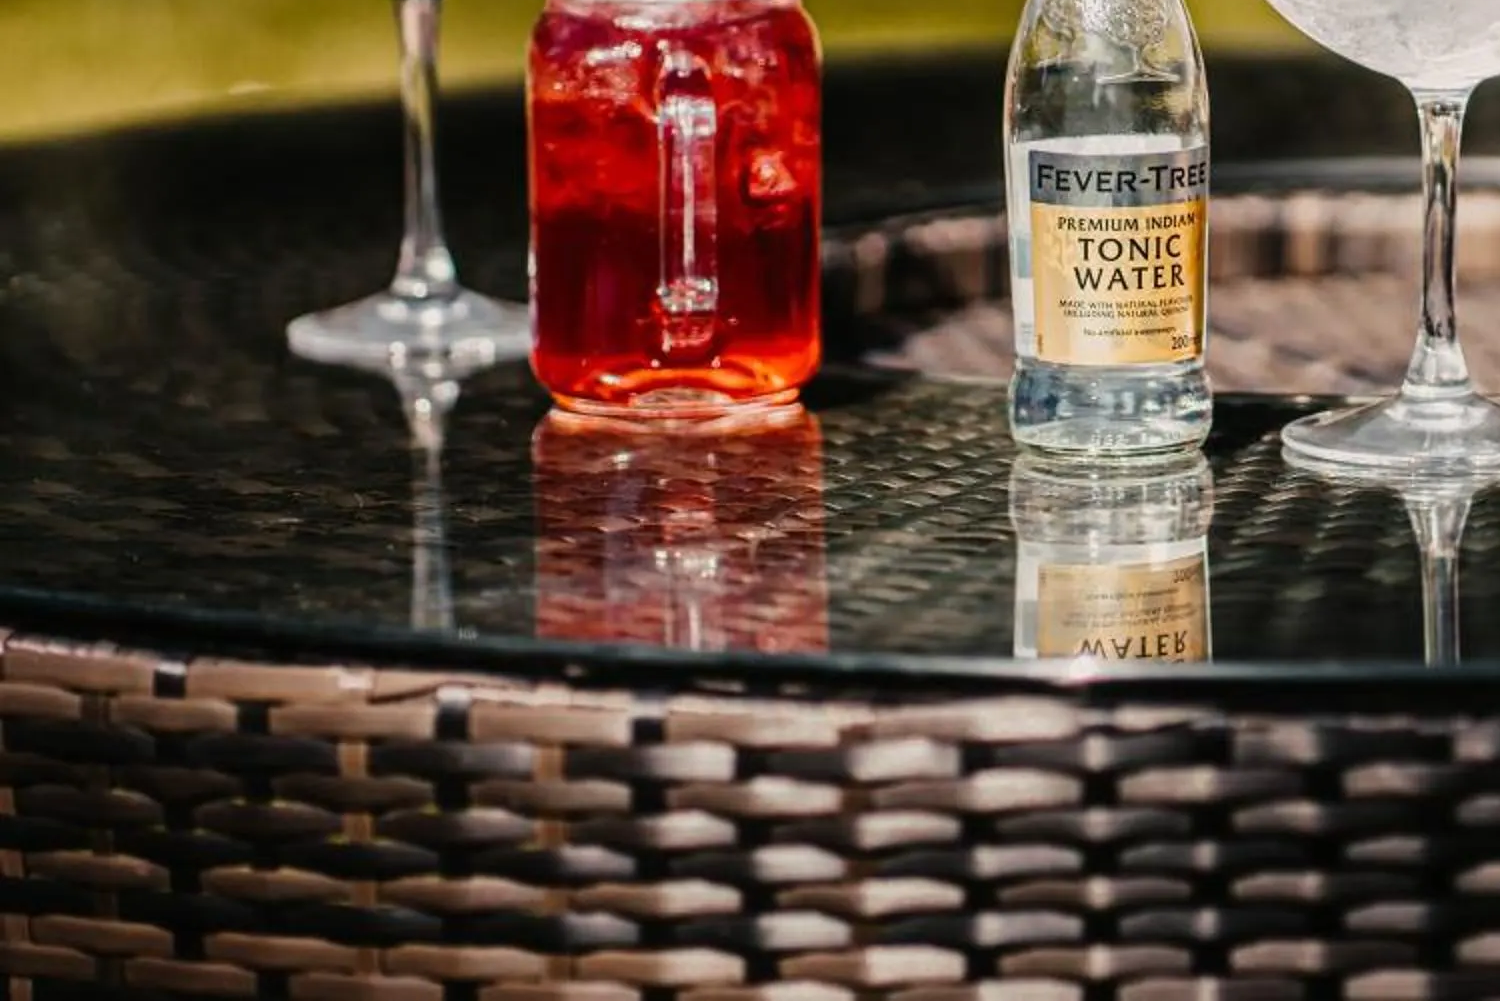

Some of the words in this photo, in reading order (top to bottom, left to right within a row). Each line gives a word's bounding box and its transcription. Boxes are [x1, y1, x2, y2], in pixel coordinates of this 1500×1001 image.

[1037, 162, 1206, 192] FEVER-TREE
[1057, 216, 1139, 231] PREMIUM
[1146, 213, 1195, 230] INDIAN
[1078, 234, 1182, 262] TONIC
[1074, 263, 1185, 290] WATER
[1089, 301, 1113, 309] WITH
